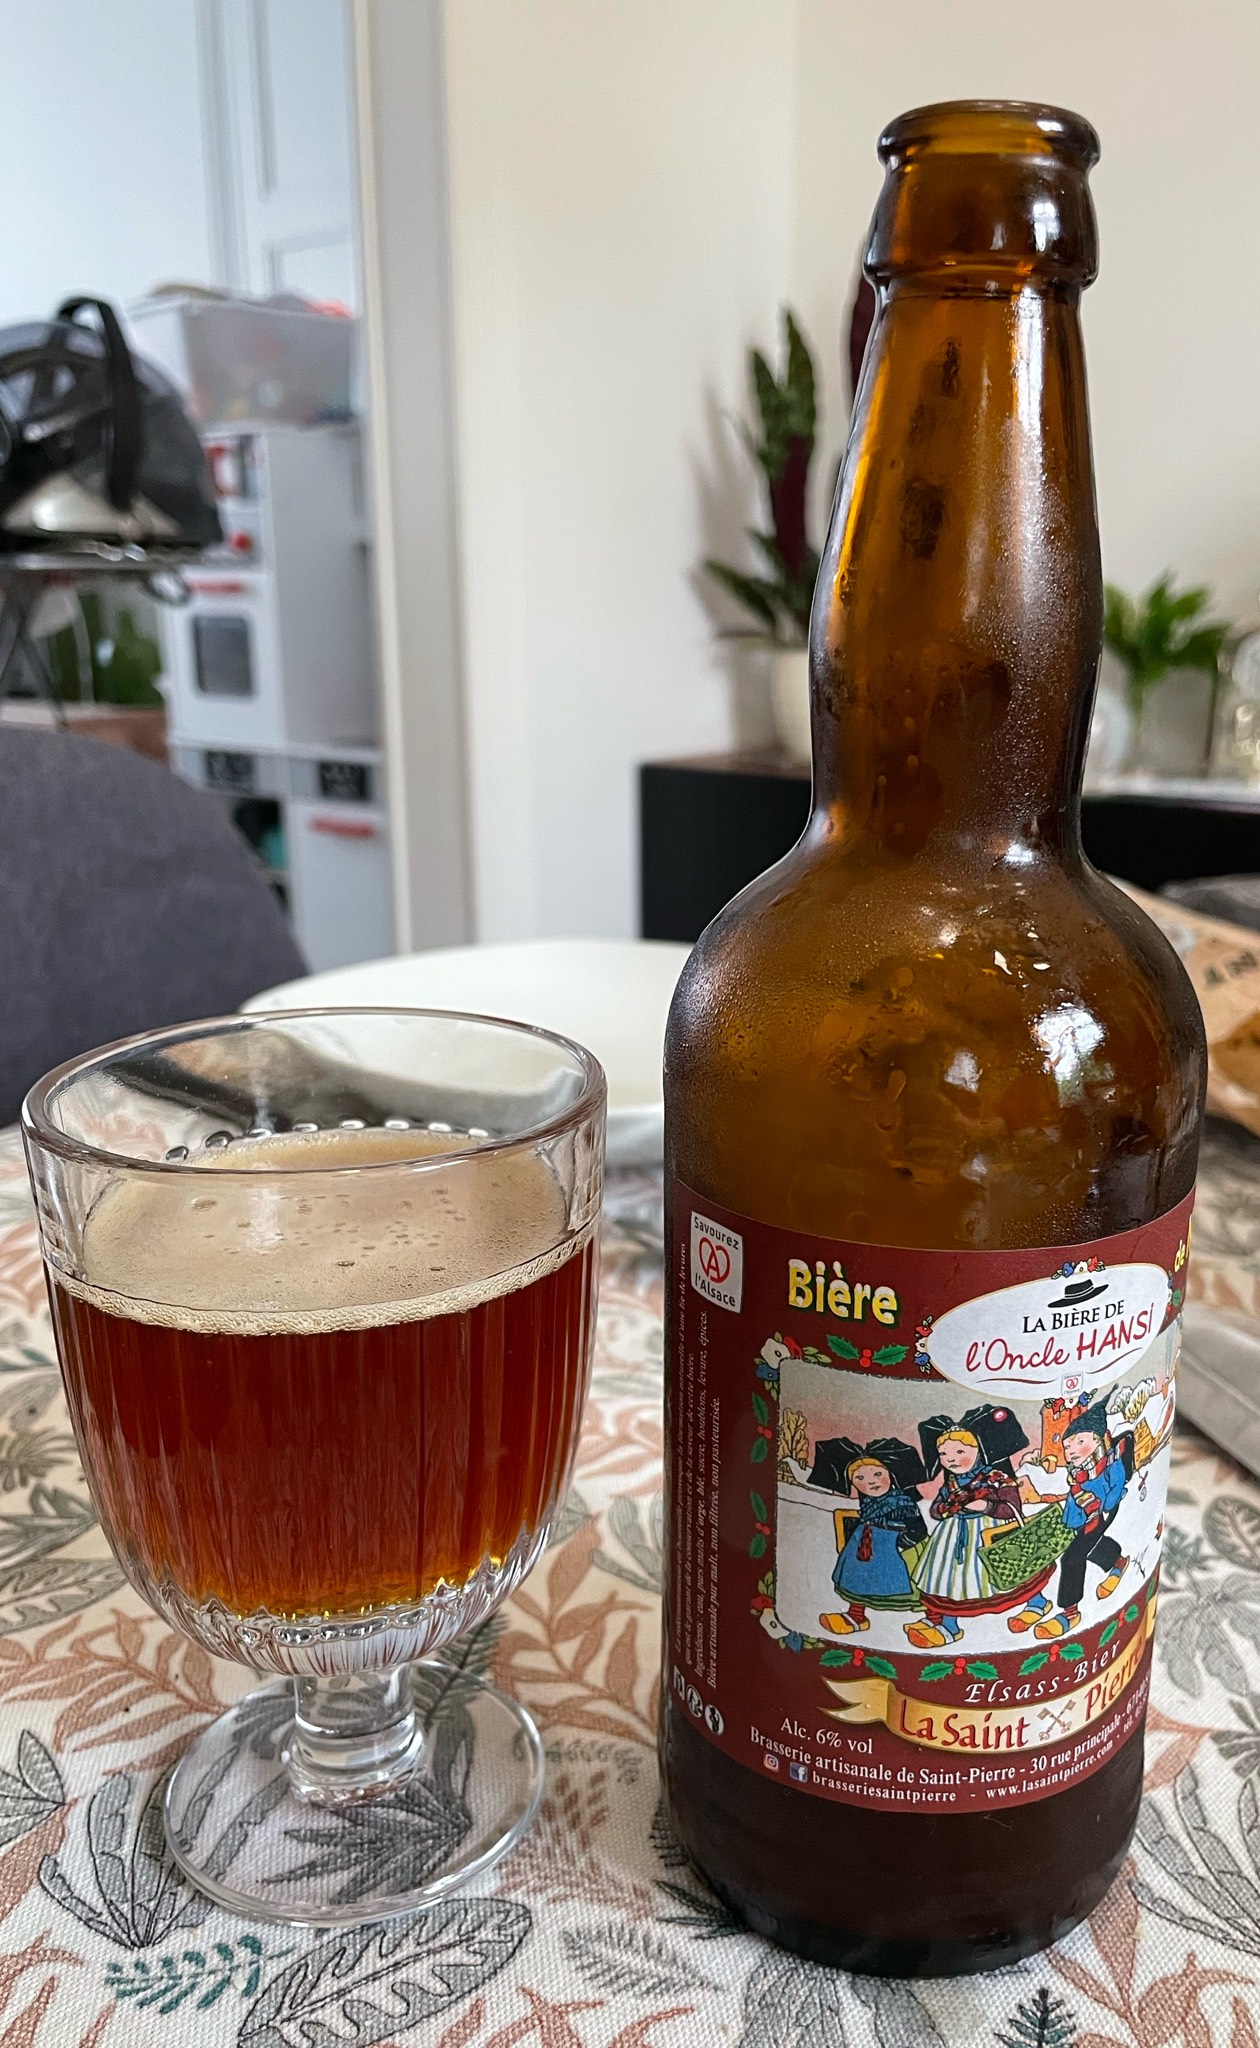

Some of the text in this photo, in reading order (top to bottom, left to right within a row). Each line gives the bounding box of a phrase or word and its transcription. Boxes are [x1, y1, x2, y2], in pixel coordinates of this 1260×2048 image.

[694, 1216, 739, 1250] Savourez
[695, 1272, 736, 1307] l'Alsace
[788, 1258, 898, 1325] Bière
[1022, 1299, 1125, 1334] LA BIÈRE DE
[697, 1350, 707, 1386] levure,
[965, 1336, 1070, 1373] l'Oncle
[709, 1397, 721, 1464] pasteurisée.
[697, 1443, 706, 1474] sucre,
[711, 1465, 719, 1487] non
[696, 1539, 704, 1567] malts
[710, 1528, 718, 1551] non
[709, 1582, 719, 1607] pur
[707, 1604, 717, 1659] artisanale
[707, 1659, 717, 1689] Bière
[964, 1639, 1121, 1703] Elsass-Bier
[1084, 1636, 1143, 1722] Pierre
[750, 1725, 812, 1764] Brasserie
[815, 1754, 892, 1781] artisanale
[897, 1766, 915, 1783] de
[919, 1767, 1016, 1785] Saint-Pierre
[1029, 1755, 1048, 1774] 30
[1050, 1749, 1072, 1768] rue
[1073, 1714, 1121, 1762] principale
[780, 1717, 873, 1754] Alc. 6% vol
[812, 1770, 956, 1803] brasseriesaintpierre
[986, 1740, 1113, 1799] www.lasaintpierre.com
